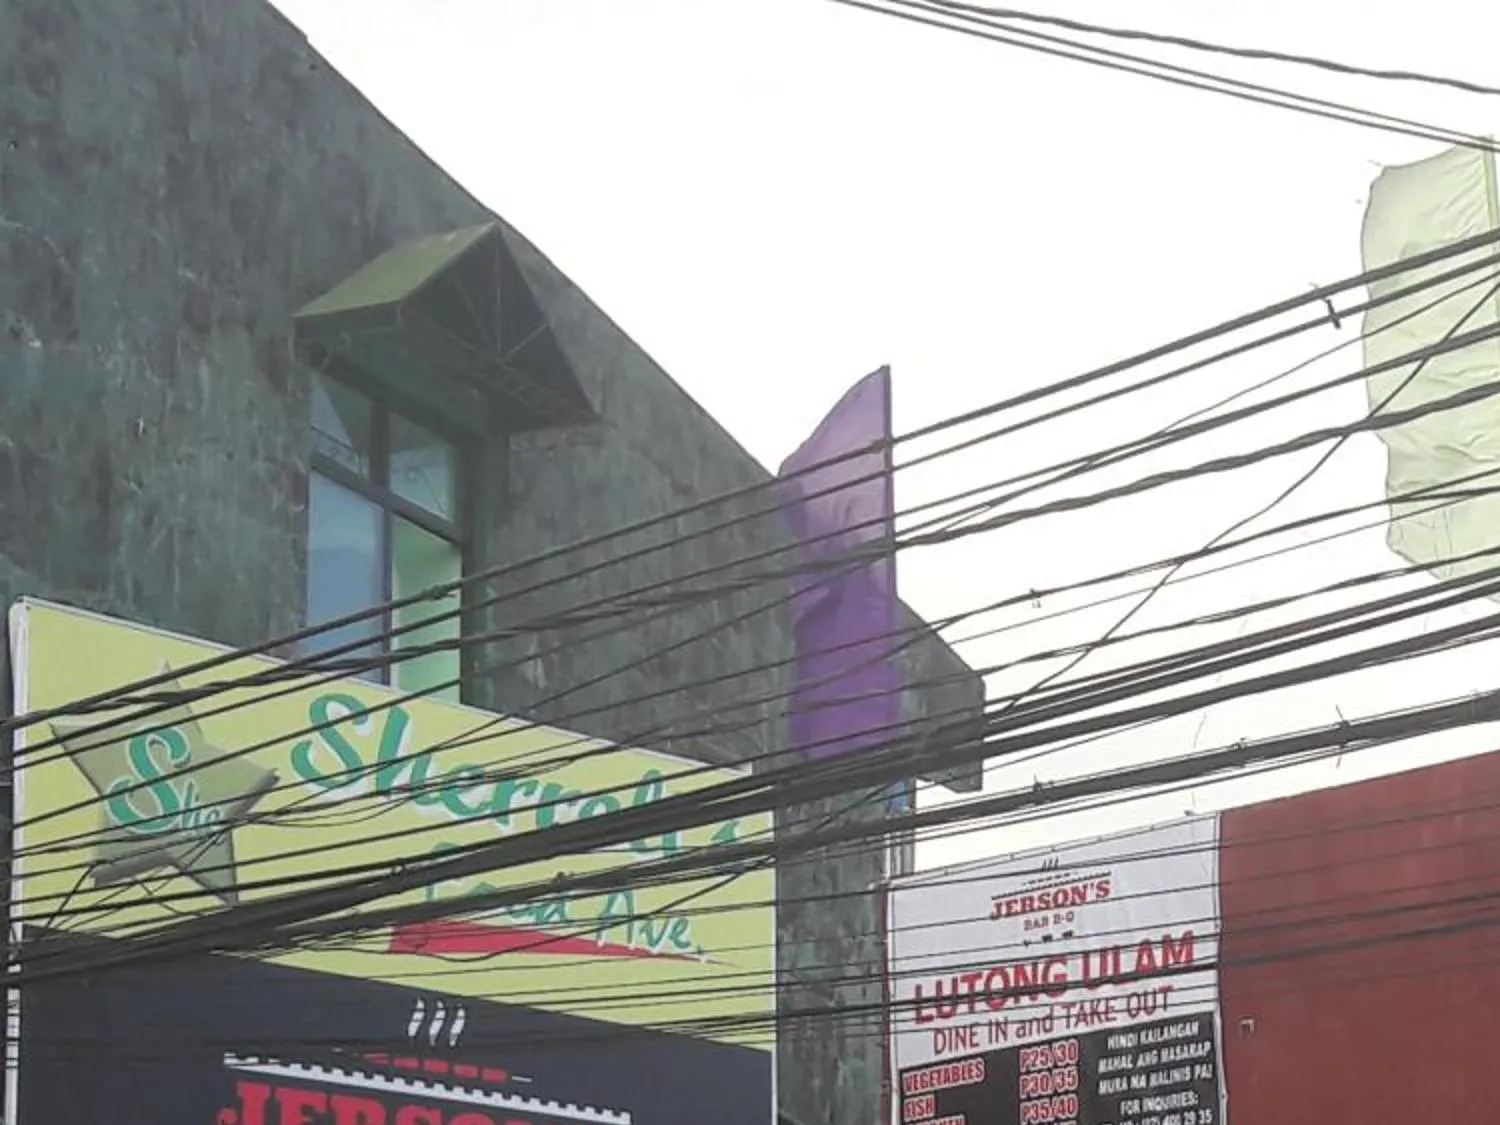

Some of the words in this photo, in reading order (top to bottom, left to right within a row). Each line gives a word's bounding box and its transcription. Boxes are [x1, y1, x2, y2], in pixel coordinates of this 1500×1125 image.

[989, 879, 1111, 920] JERSON'S
[913, 953, 1068, 1025] LUTONG
[1081, 928, 1195, 991] ULAM
[932, 1026, 980, 1055] DINE
[987, 1016, 1009, 1046] IN
[1015, 1014, 1053, 1039] and
[1060, 1000, 1117, 1030] TAKE
[1124, 984, 1175, 1018] OUT
[1107, 1034, 1138, 1050] HINDI
[1139, 1021, 1200, 1044] KAILANGAN
[1019, 1038, 1079, 1073] P25/30
[1097, 1053, 1134, 1073] MAHAL
[1136, 1051, 1159, 1068] ANG
[1160, 1041, 1213, 1064] MASARAP
[902, 1057, 985, 1096] VEGETABLES
[1019, 1065, 1079, 1099] P30/35
[1097, 1076, 1128, 1096] MURA
[1130, 1074, 1147, 1089] NA
[1150, 1065, 1192, 1089] MALINIS
[904, 1094, 936, 1122] FISH
[1020, 1093, 1079, 1125] P35/40
[1120, 1098, 1141, 1117] FOR
[1199, 1109, 1213, 1125] 35
